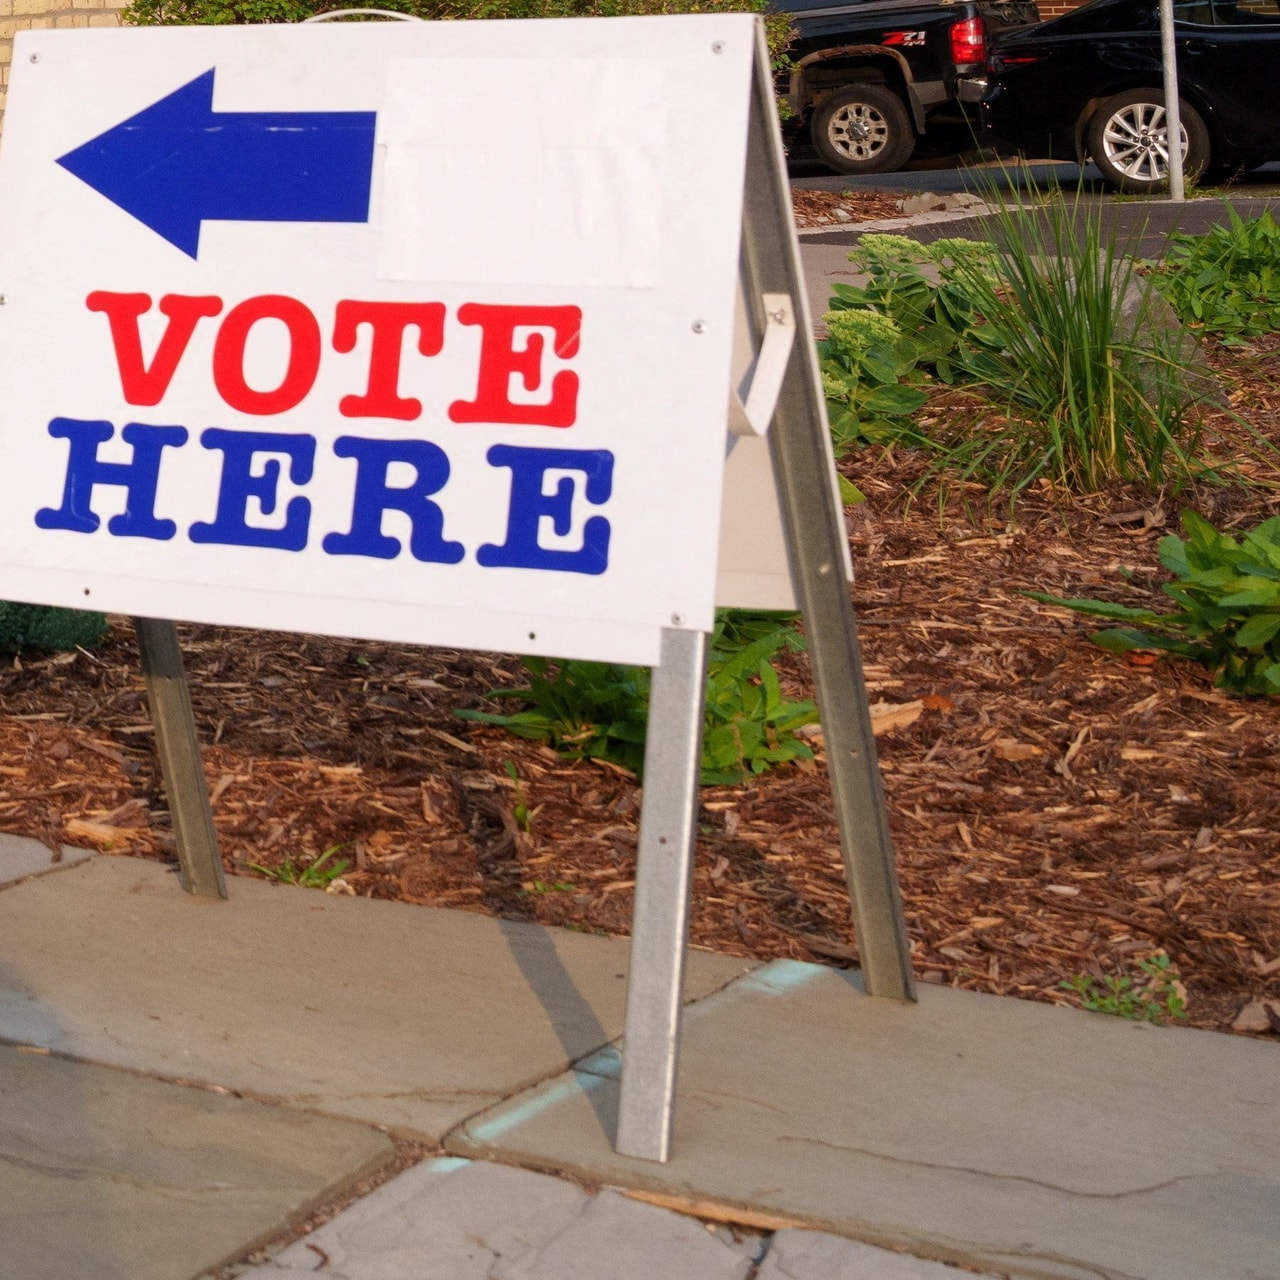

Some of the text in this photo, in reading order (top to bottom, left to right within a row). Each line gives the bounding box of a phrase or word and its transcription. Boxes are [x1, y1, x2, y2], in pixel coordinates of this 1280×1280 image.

[882, 31, 926, 45] Z71
[87, 291, 581, 427] VOTE
[36, 418, 614, 574] HERE
